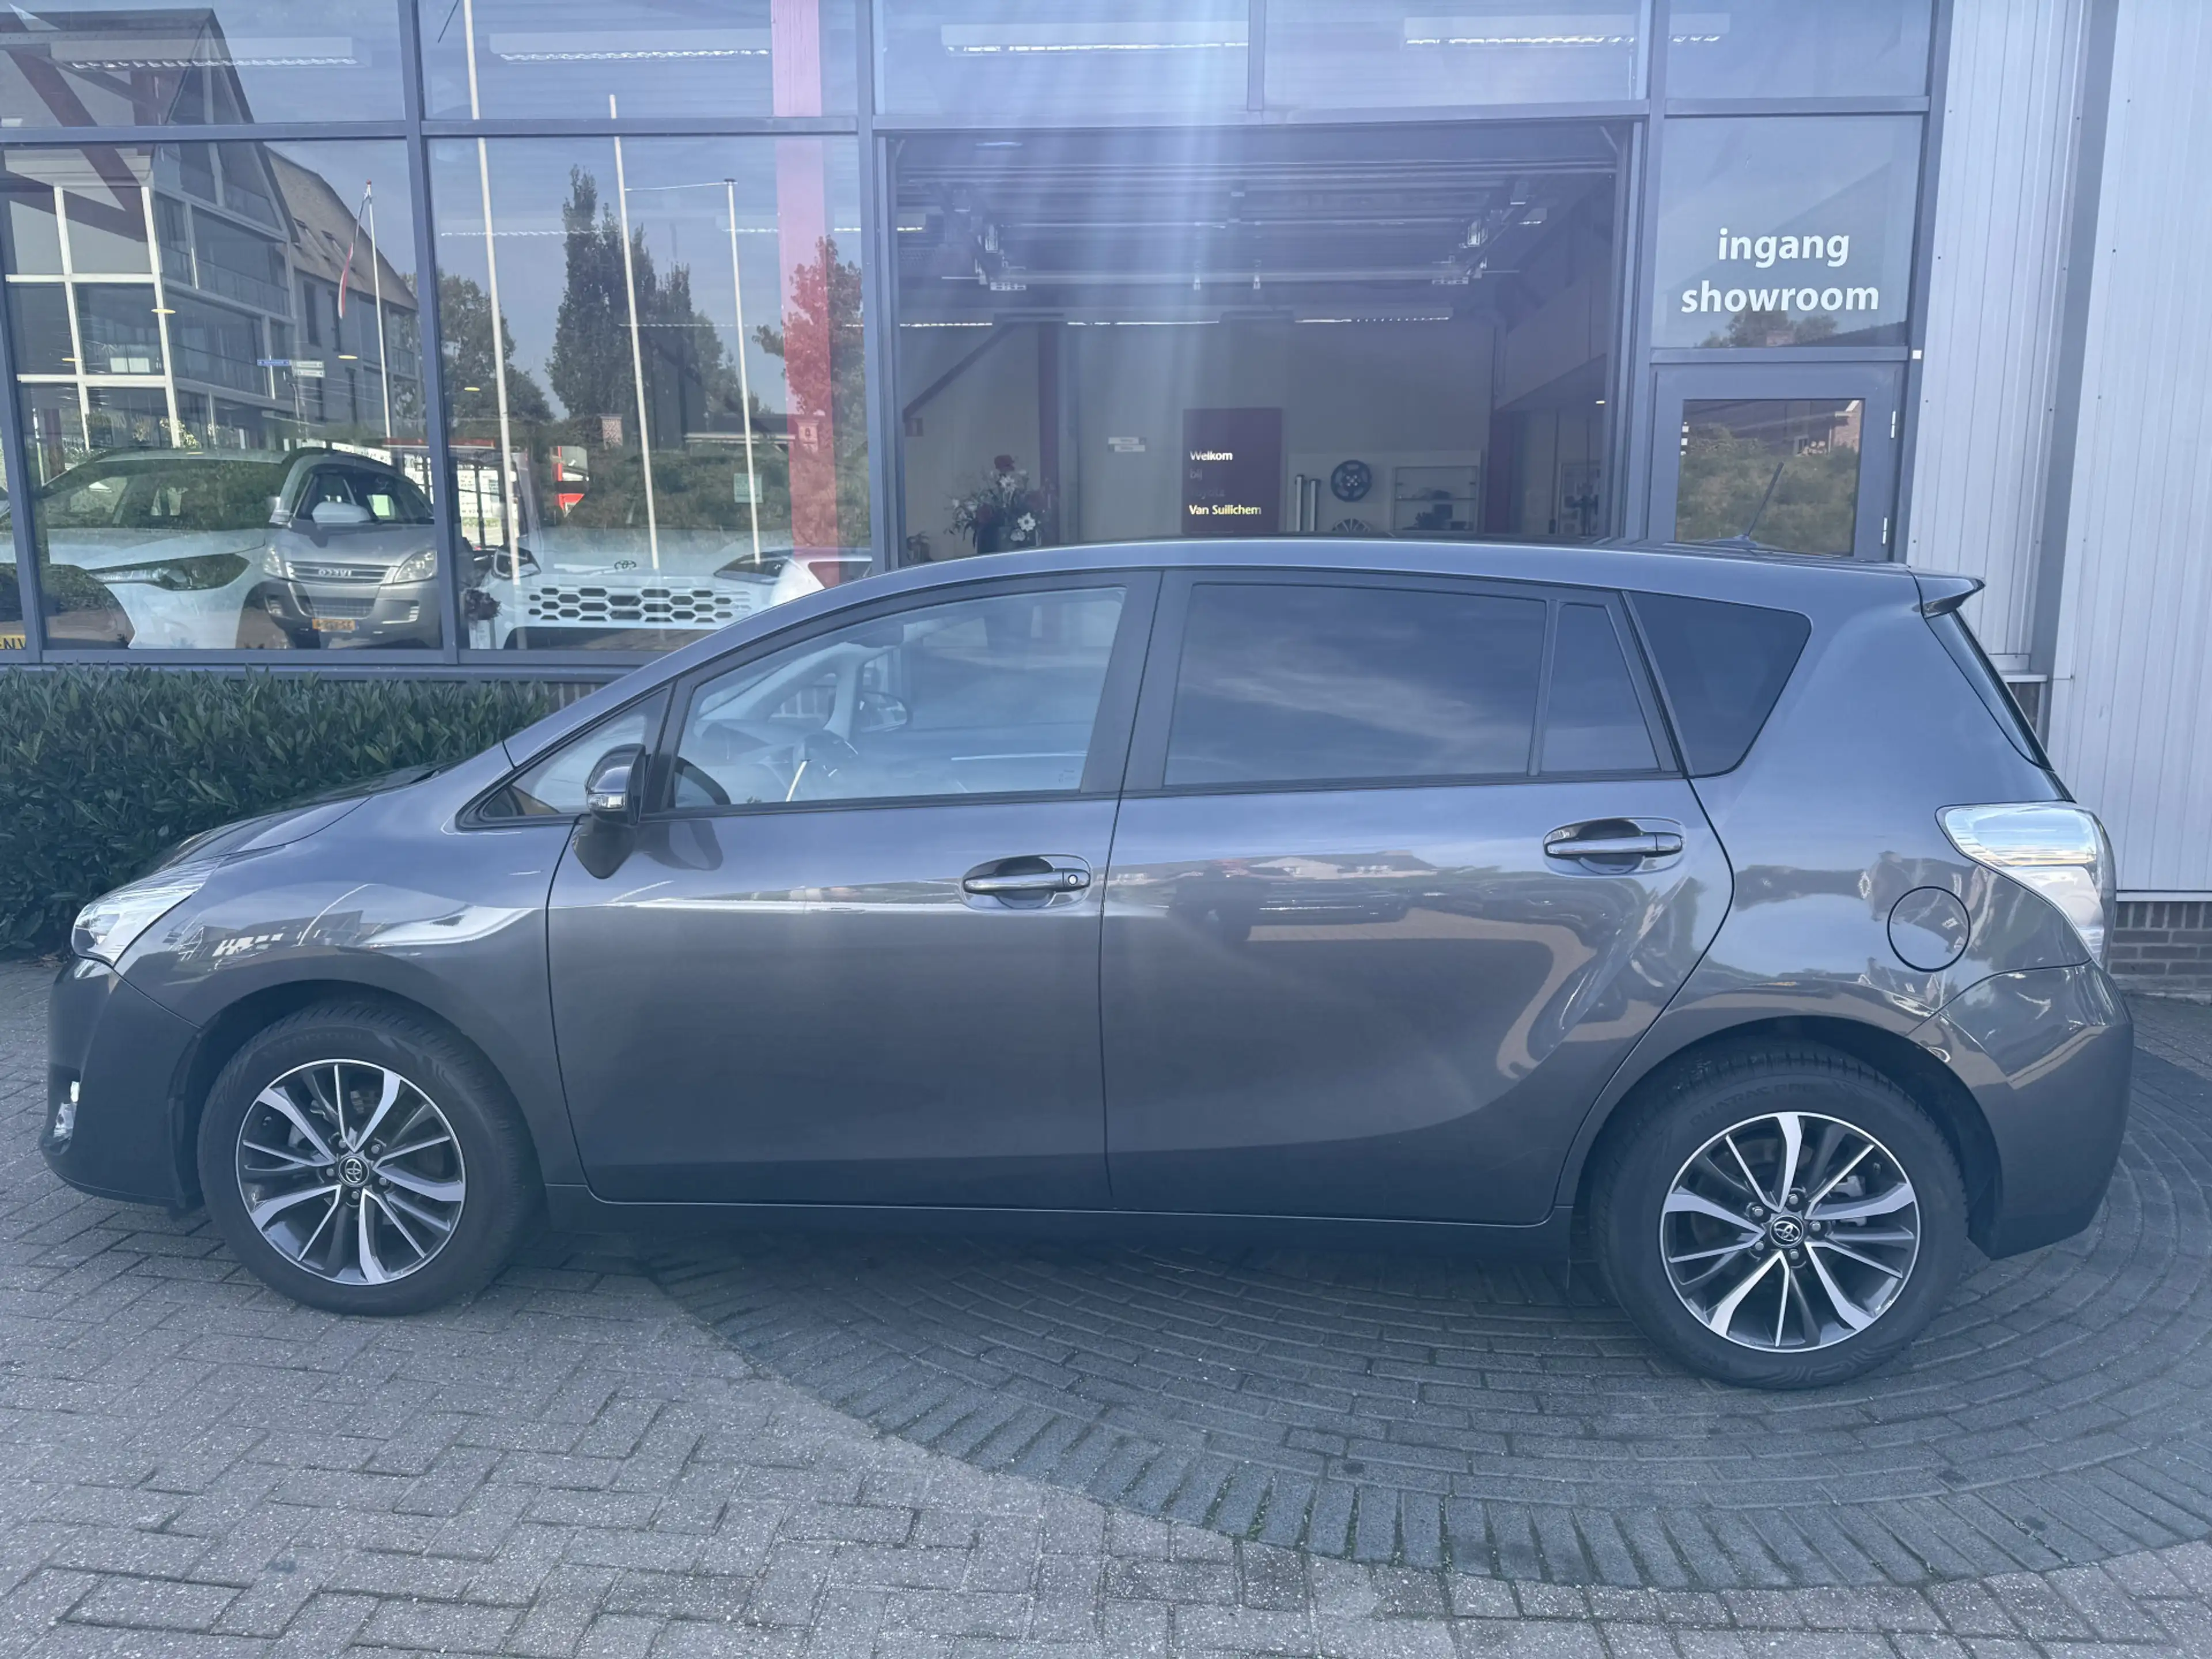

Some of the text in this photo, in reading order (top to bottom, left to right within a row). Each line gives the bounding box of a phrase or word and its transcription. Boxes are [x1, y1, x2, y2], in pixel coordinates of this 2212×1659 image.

[1718, 228, 1850, 268] ingang
[1680, 280, 1880, 313] showroom
[1190, 450, 1233, 460] Welkom
[1189, 505, 1209, 514] Van
